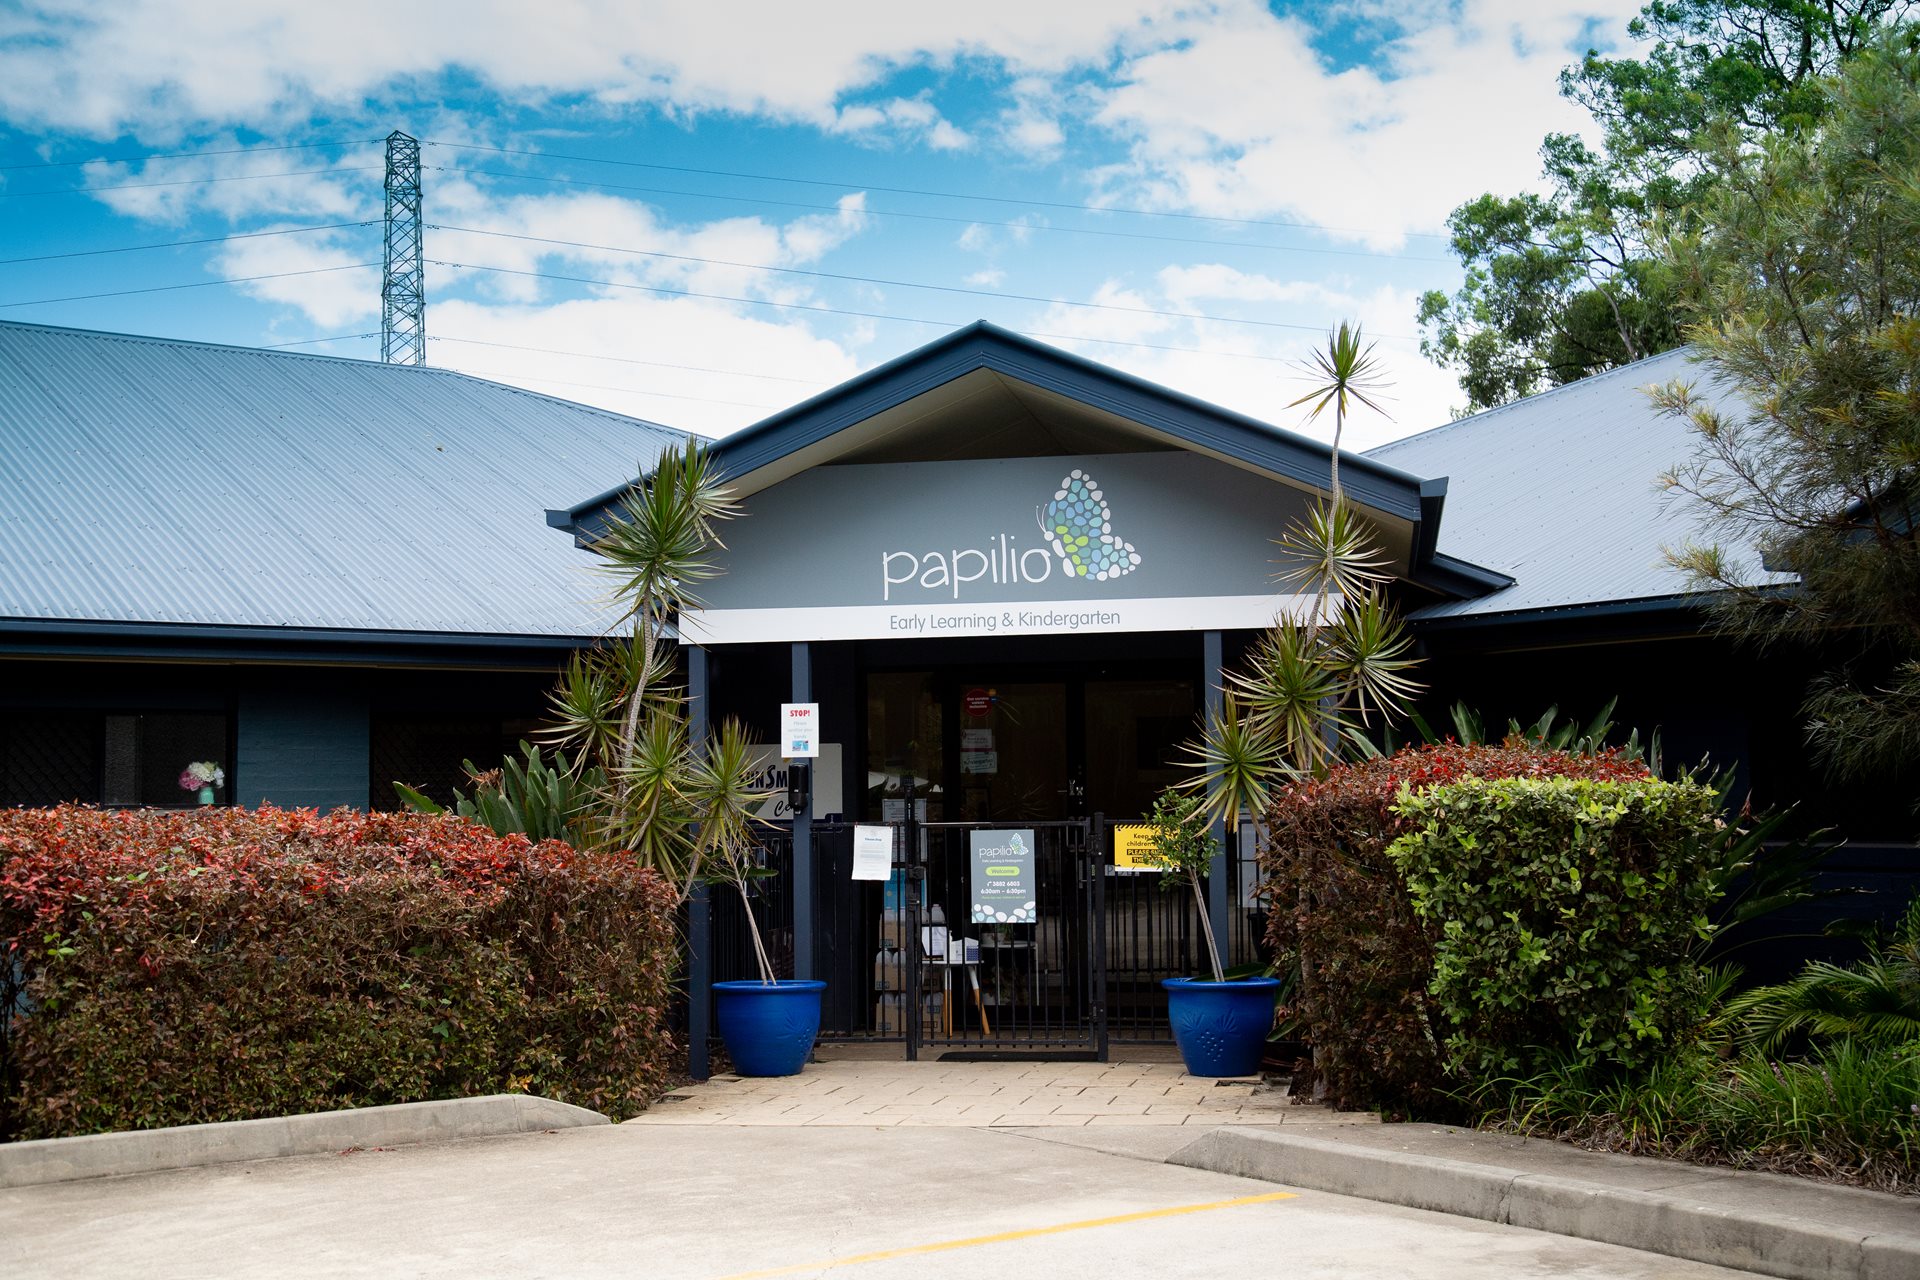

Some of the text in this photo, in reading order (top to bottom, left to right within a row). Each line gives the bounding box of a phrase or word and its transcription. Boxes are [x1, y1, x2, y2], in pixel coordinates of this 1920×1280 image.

[883, 533, 1051, 601] papilio
[890, 610, 1120, 633] Early Learning & Kindergarten
[790, 709, 811, 717] STOP!
[979, 845, 1013, 859] papilio
